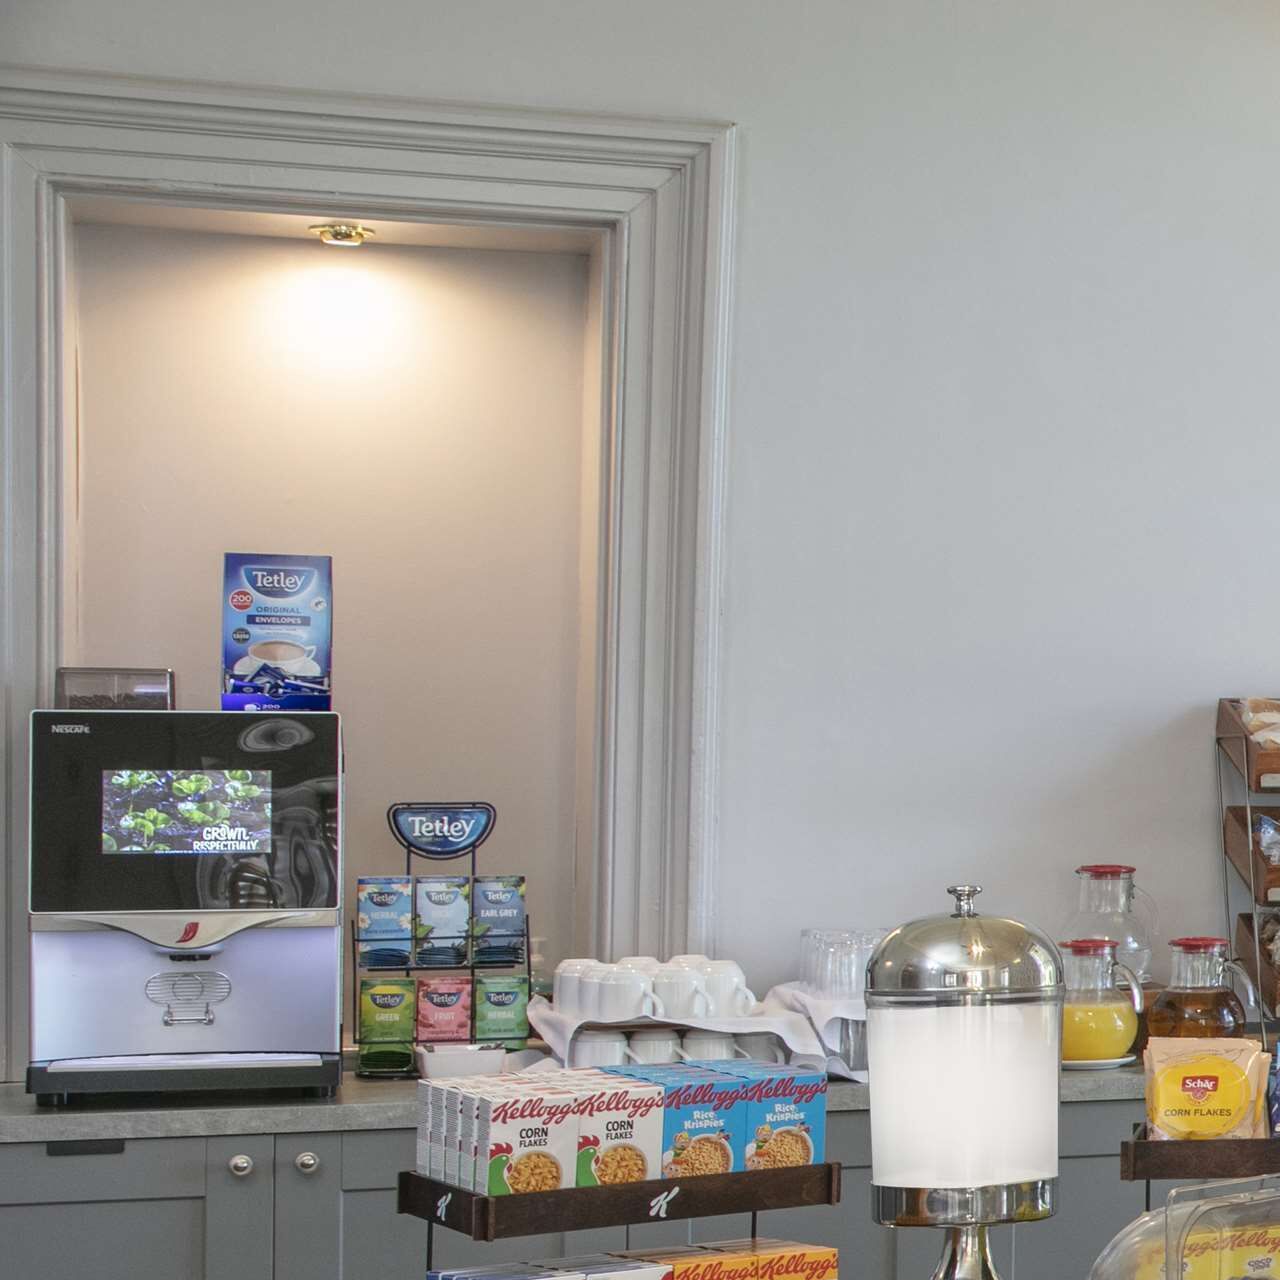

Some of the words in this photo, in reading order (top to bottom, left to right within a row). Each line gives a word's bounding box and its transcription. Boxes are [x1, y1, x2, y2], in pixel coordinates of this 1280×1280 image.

[252, 571, 305, 592] Tetley
[256, 606, 302, 614] ORIGINAL
[255, 616, 302, 624] ENVELOPES
[408, 816, 476, 842] Tetley
[371, 892, 398, 905] Tetley
[430, 891, 456, 903] Tetley
[485, 890, 513, 902] Tetley
[481, 909, 497, 918] EARL
[499, 909, 518, 918] GREY
[374, 994, 401, 1006] Tetley
[430, 993, 458, 1005] Tetley
[488, 992, 515, 1004] Tetley
[375, 1013, 400, 1022] GREEN
[434, 1011, 456, 1021] FRUIT
[748, 1076, 828, 1104] Kellogg's
[664, 1082, 749, 1111] Kellogg's
[580, 1090, 665, 1118] Kellogg's
[775, 1103, 798, 1113] Rice
[492, 1097, 580, 1126] Kellogg's
[693, 1110, 717, 1120] Rice
[766, 1111, 806, 1122] Krispies
[1164, 1108, 1191, 1117] CORN
[1194, 1108, 1232, 1117] FLAKES
[605, 1119, 634, 1132] CORN
[684, 1118, 725, 1130] Krispies
[519, 1127, 549, 1139] CORN
[605, 1130, 633, 1140] FLAKES
[519, 1138, 548, 1148] FLAKES
[759, 1252, 838, 1280] Kellogg's
